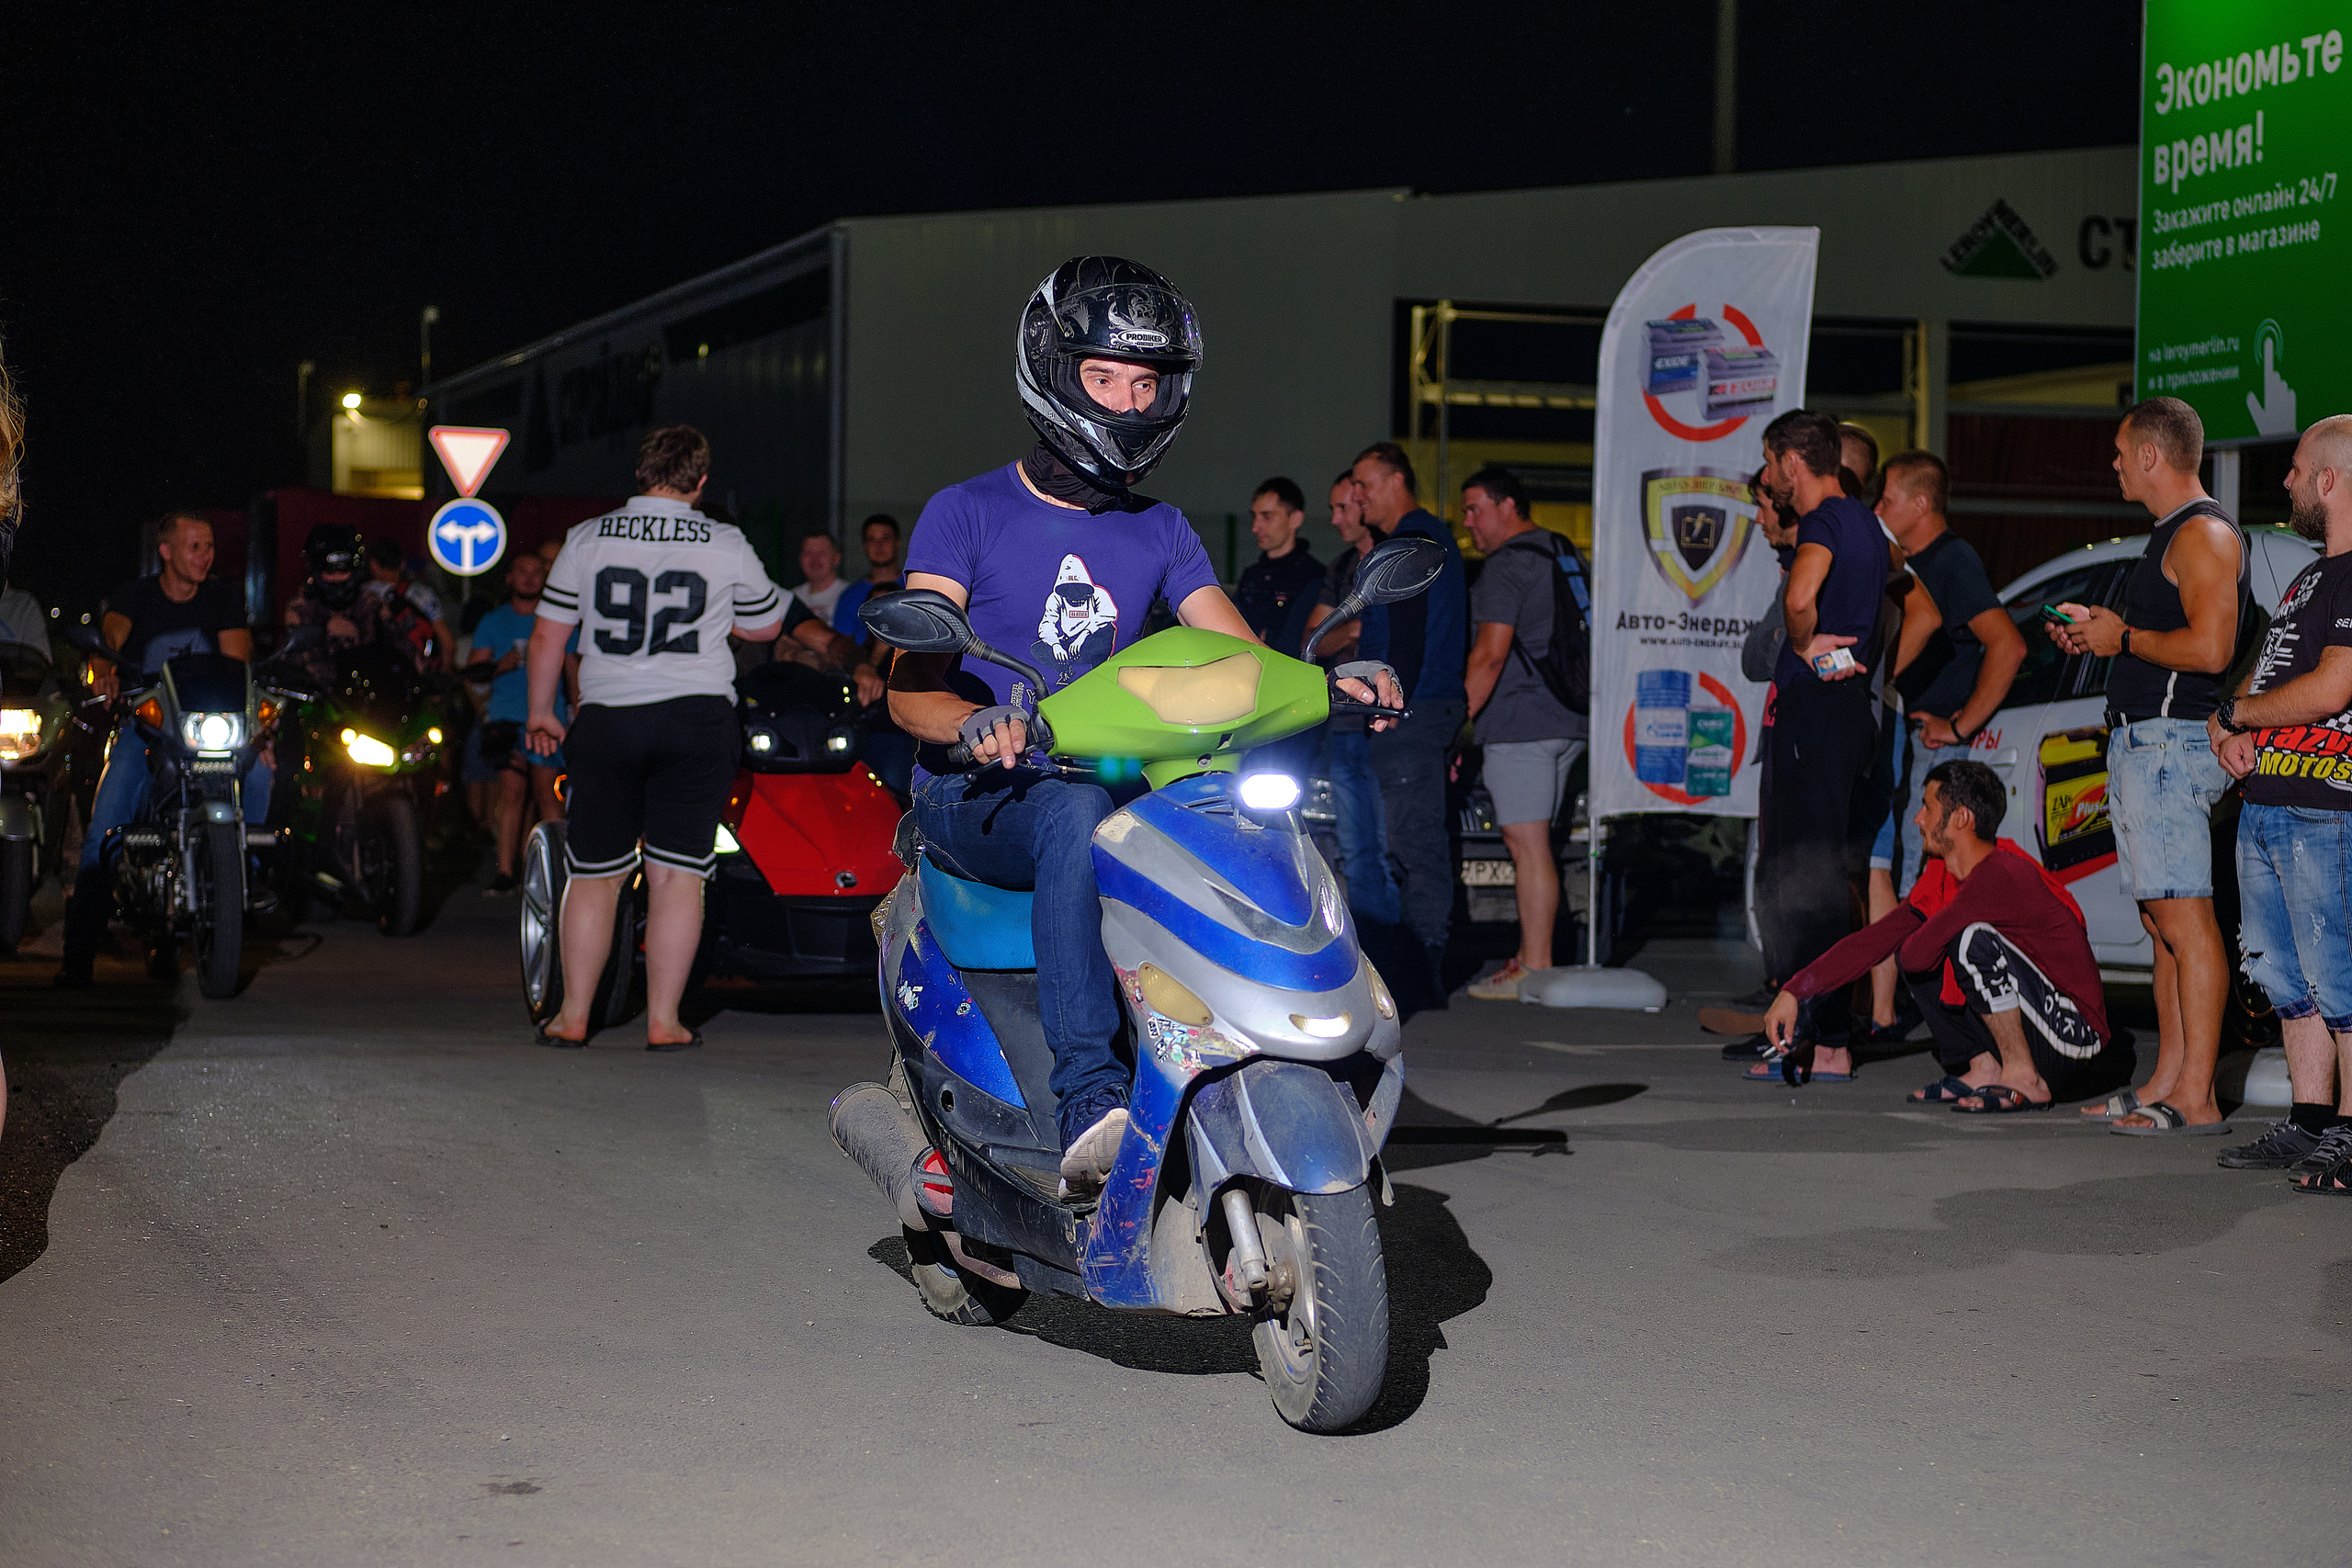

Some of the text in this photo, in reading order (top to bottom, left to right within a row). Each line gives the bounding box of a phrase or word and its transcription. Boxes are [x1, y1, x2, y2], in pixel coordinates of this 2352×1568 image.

[2155, 29, 2343, 115] Экономьте
[2154, 110, 2264, 195] время!
[2153, 172, 2337, 233] Закажите онлайн 24/7
[2152, 220, 2321, 270] заберите в магазине
[1125, 333, 1163, 344] PROBIKER
[594, 566, 707, 656] 92
